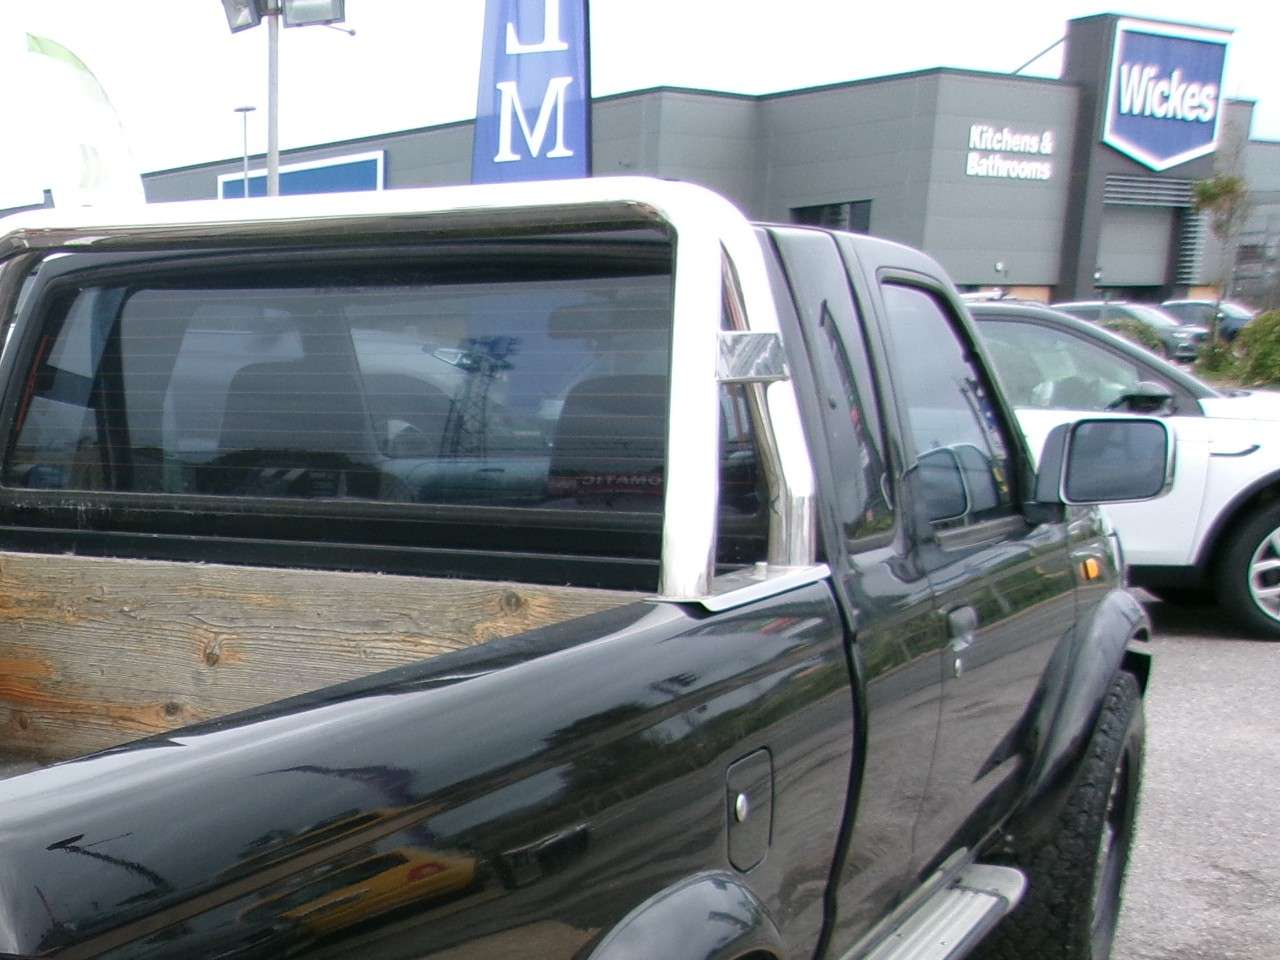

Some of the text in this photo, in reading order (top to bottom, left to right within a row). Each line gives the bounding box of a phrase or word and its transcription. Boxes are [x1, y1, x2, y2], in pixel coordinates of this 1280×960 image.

[1119, 63, 1217, 122] Wickes
[968, 125, 1054, 154] Kitchens &
[966, 152, 1052, 180] Bathrooms
